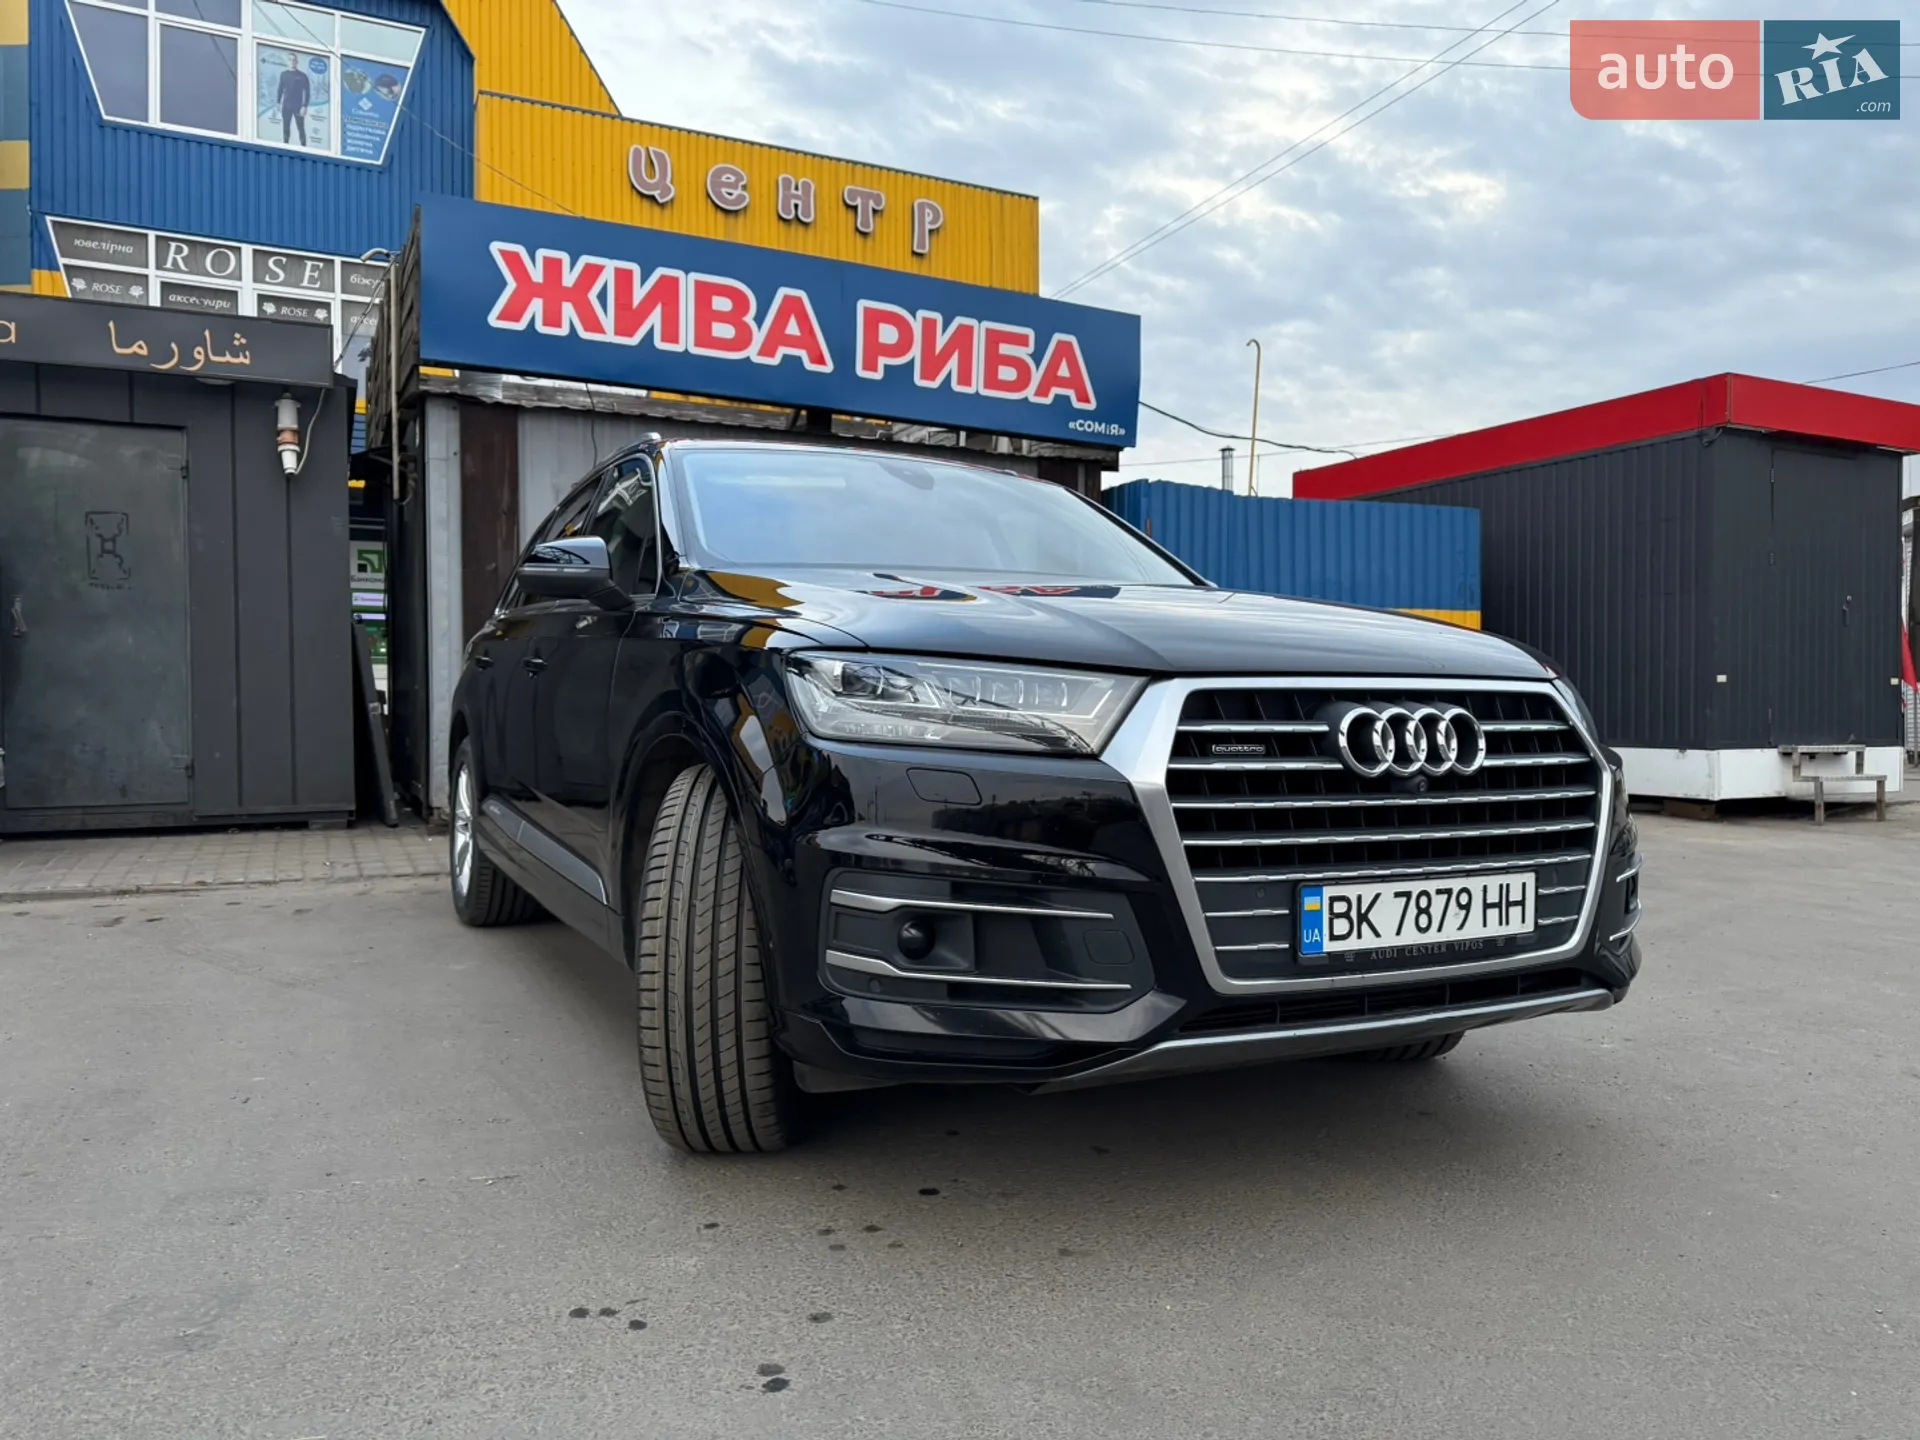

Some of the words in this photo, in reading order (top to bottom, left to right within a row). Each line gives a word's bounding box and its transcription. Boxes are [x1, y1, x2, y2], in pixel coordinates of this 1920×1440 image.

[74, 238, 133, 254] ювелірна
[163, 241, 324, 288] ROSE
[91, 282, 123, 295] ROSE
[350, 273, 384, 289] біжу
[280, 306, 309, 317] ROSE
[489, 241, 833, 373] ЖИВА
[856, 299, 1097, 411] РИБА
[1328, 894, 1382, 942] BK
[1393, 886, 1472, 937] 7879
[1482, 881, 1527, 928] HH
[1303, 929, 1321, 943] UA
[1370, 950, 1399, 960] AUDI
[1405, 946, 1448, 957] CENTER
